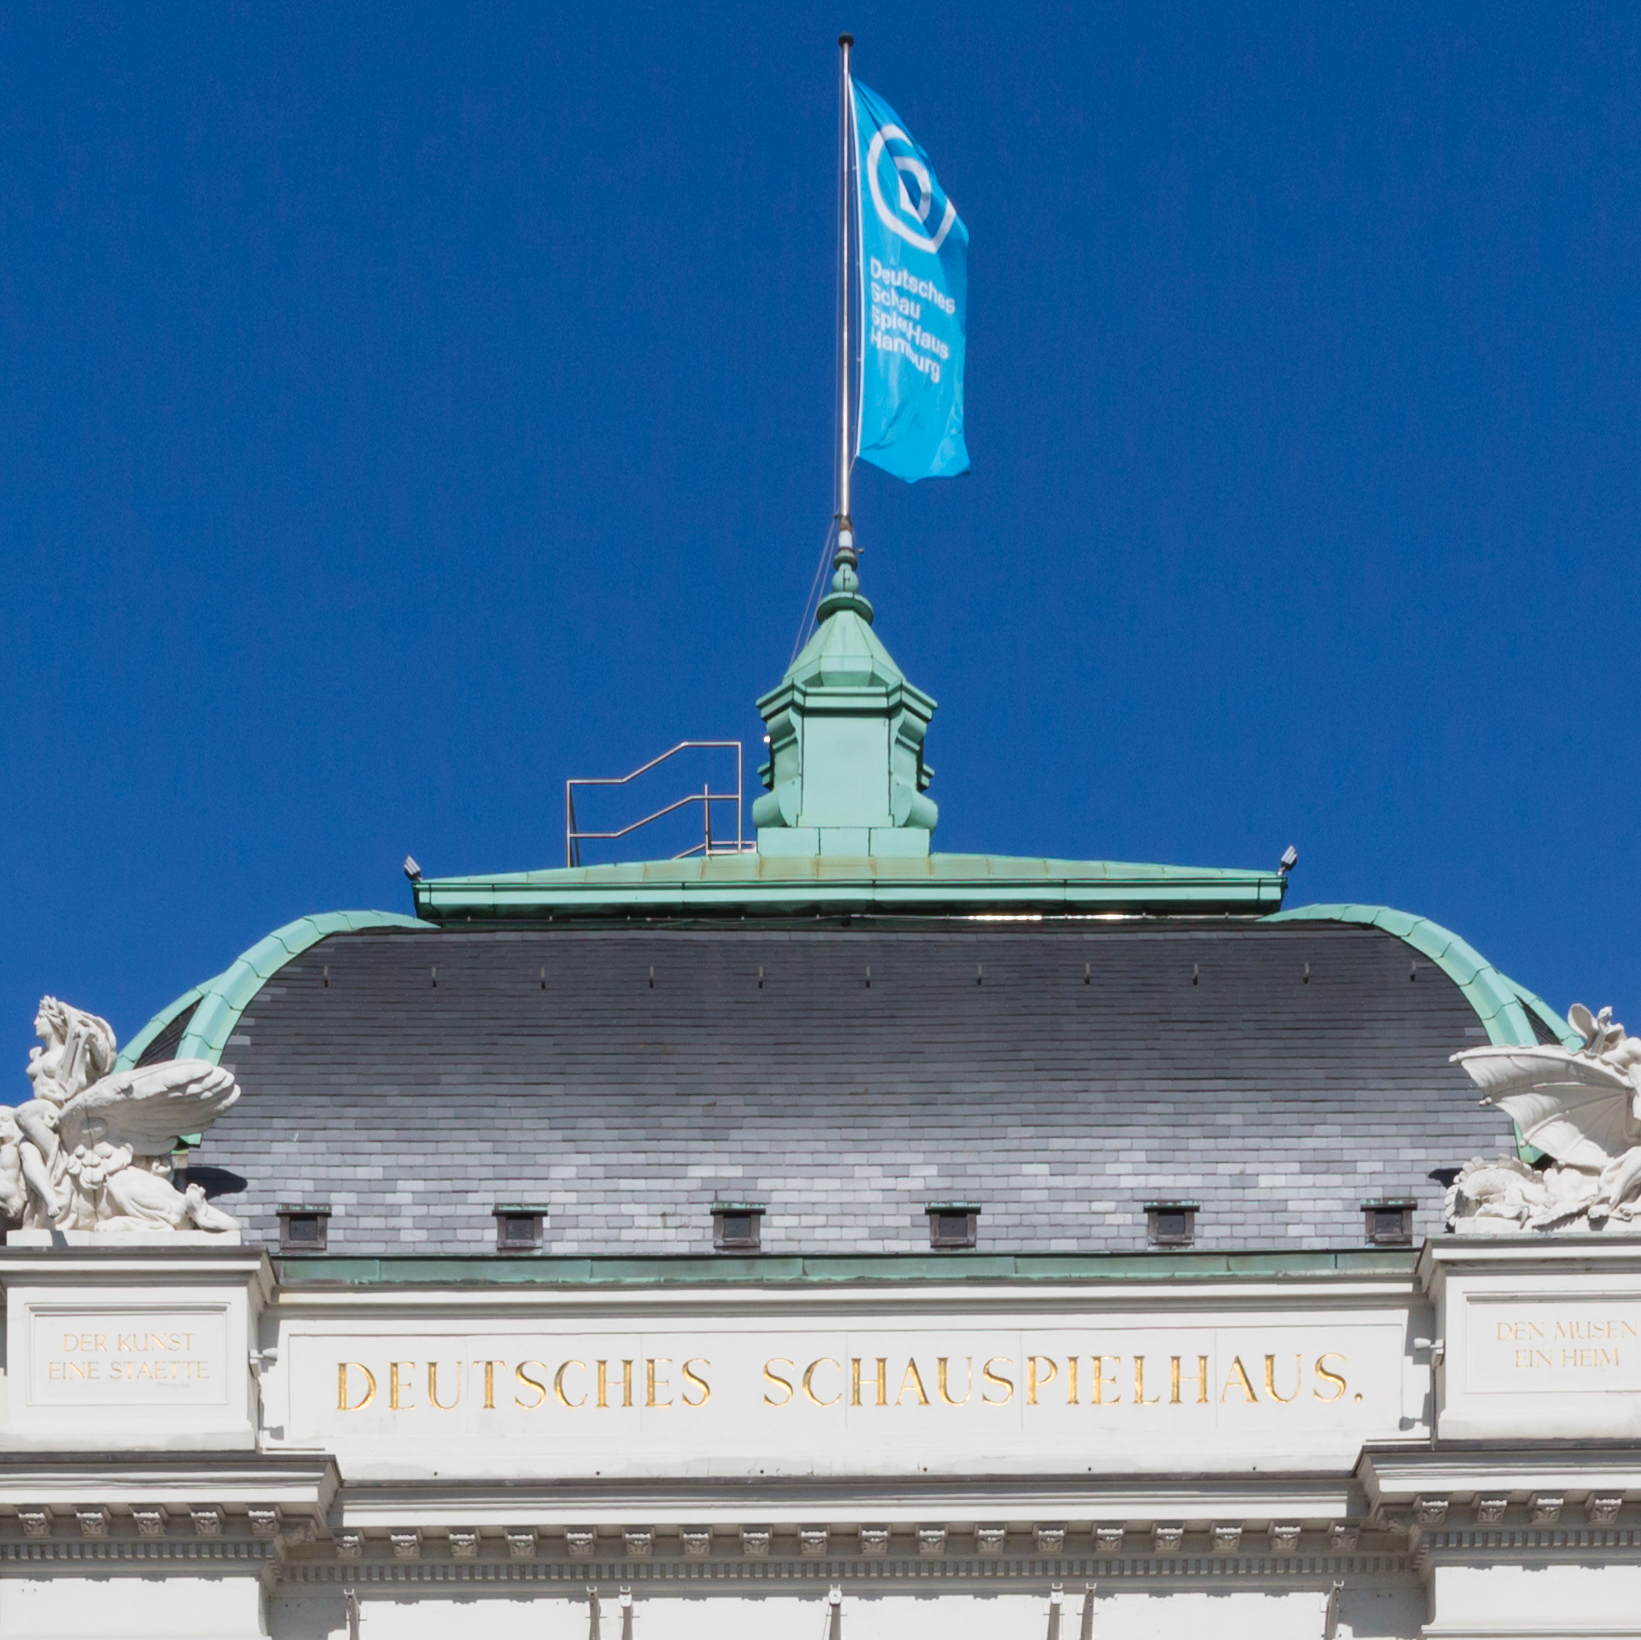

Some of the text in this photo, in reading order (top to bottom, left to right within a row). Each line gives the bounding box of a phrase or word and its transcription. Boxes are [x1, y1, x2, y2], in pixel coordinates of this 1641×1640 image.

[870, 257, 956, 315] Deutsches
[871, 281, 921, 320] Schau
[1496, 1319, 1640, 1341] DEN MUSEN
[62, 1333, 195, 1353] DER KUNST
[1514, 1348, 1621, 1369] EIN HEIM
[48, 1361, 101, 1380] EINE
[335, 1352, 1365, 1411] DEUTSCHES SCHAUSPIELHAUS.
